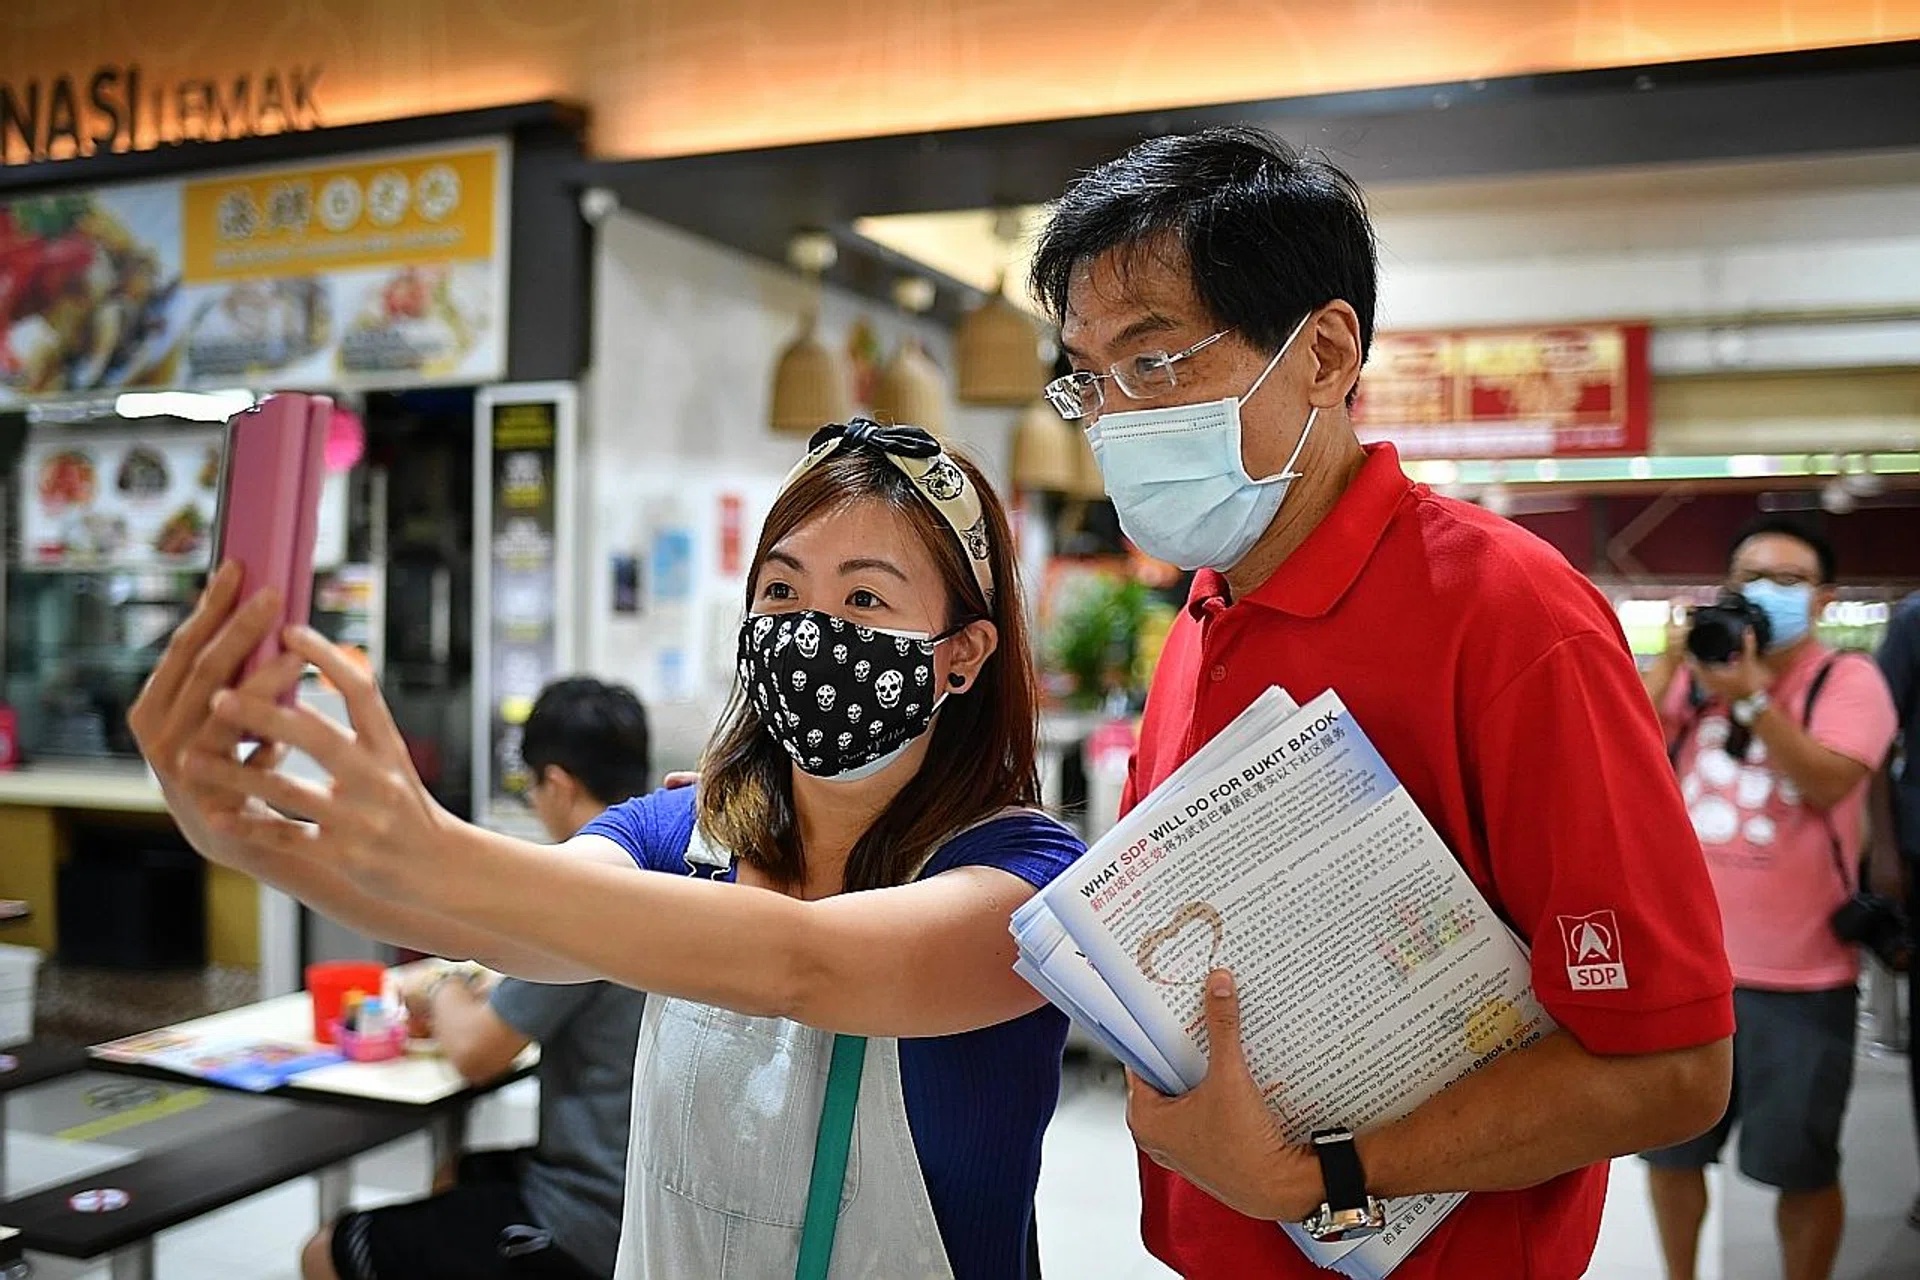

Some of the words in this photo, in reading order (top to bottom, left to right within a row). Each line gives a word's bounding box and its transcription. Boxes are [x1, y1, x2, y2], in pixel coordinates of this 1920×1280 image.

[0, 63, 140, 168] NASI
[153, 64, 325, 146] LEMAK
[1078, 858, 1122, 901] WHAT
[1117, 835, 1152, 868] SDP
[1147, 810, 1188, 845] WILL
[1183, 794, 1212, 820] DO
[1207, 774, 1244, 804] FOR
[1239, 745, 1290, 784] BUKIT
[1286, 708, 1340, 754] BATOK
[1577, 967, 1617, 985] SDP
[1472, 1042, 1505, 1069] Batok
[1512, 1015, 1541, 1040] more
[1518, 1028, 1542, 1050] one
